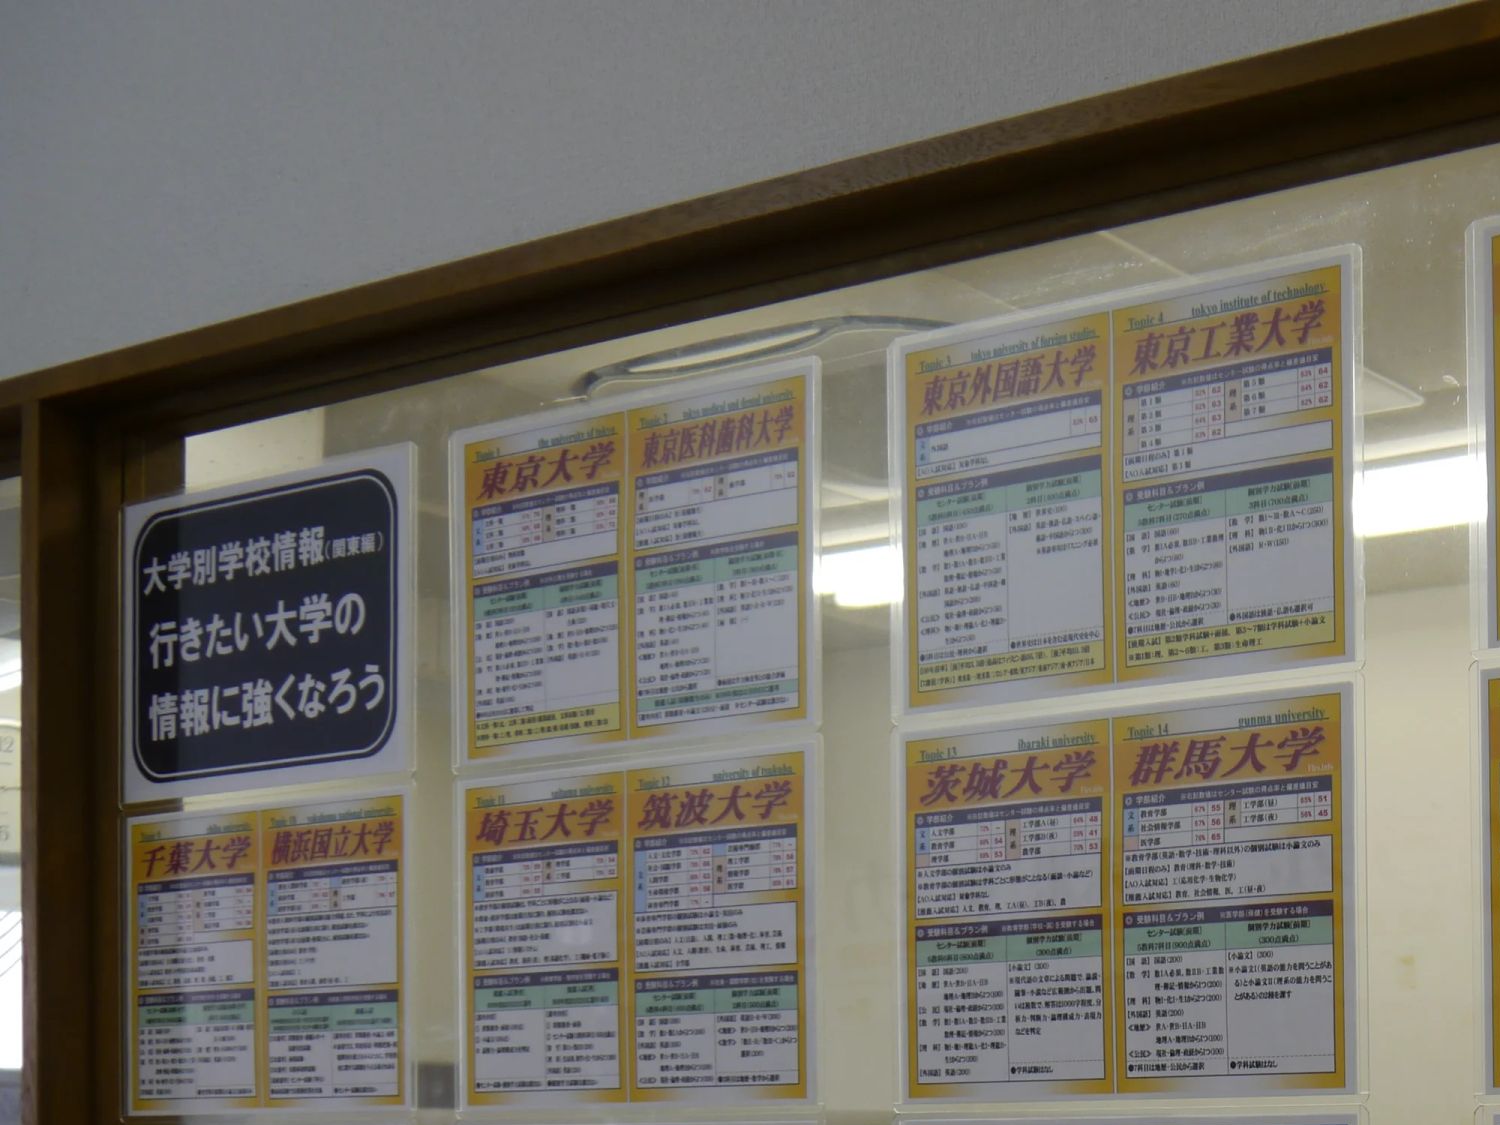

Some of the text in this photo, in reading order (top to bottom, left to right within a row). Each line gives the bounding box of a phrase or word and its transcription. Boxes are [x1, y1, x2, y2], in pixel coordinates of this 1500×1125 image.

[1129, 301, 1326, 376] 東京工業大学
[920, 345, 1097, 417] 東京外国語大学
[639, 406, 795, 470] 東京医科歯科大学
[478, 441, 616, 501] 東京大学
[148, 593, 367, 671] 行きたい大学の
[148, 663, 386, 743] 情報に強くなろう
[921, 751, 1097, 806] 茨城大学
[1130, 727, 1325, 786] 群馬大学
[475, 802, 616, 845] 埼玉大学
[638, 780, 793, 831] 筑波大学
[138, 837, 251, 876] 千葉大学
[269, 821, 393, 864] 横浜国立大学
